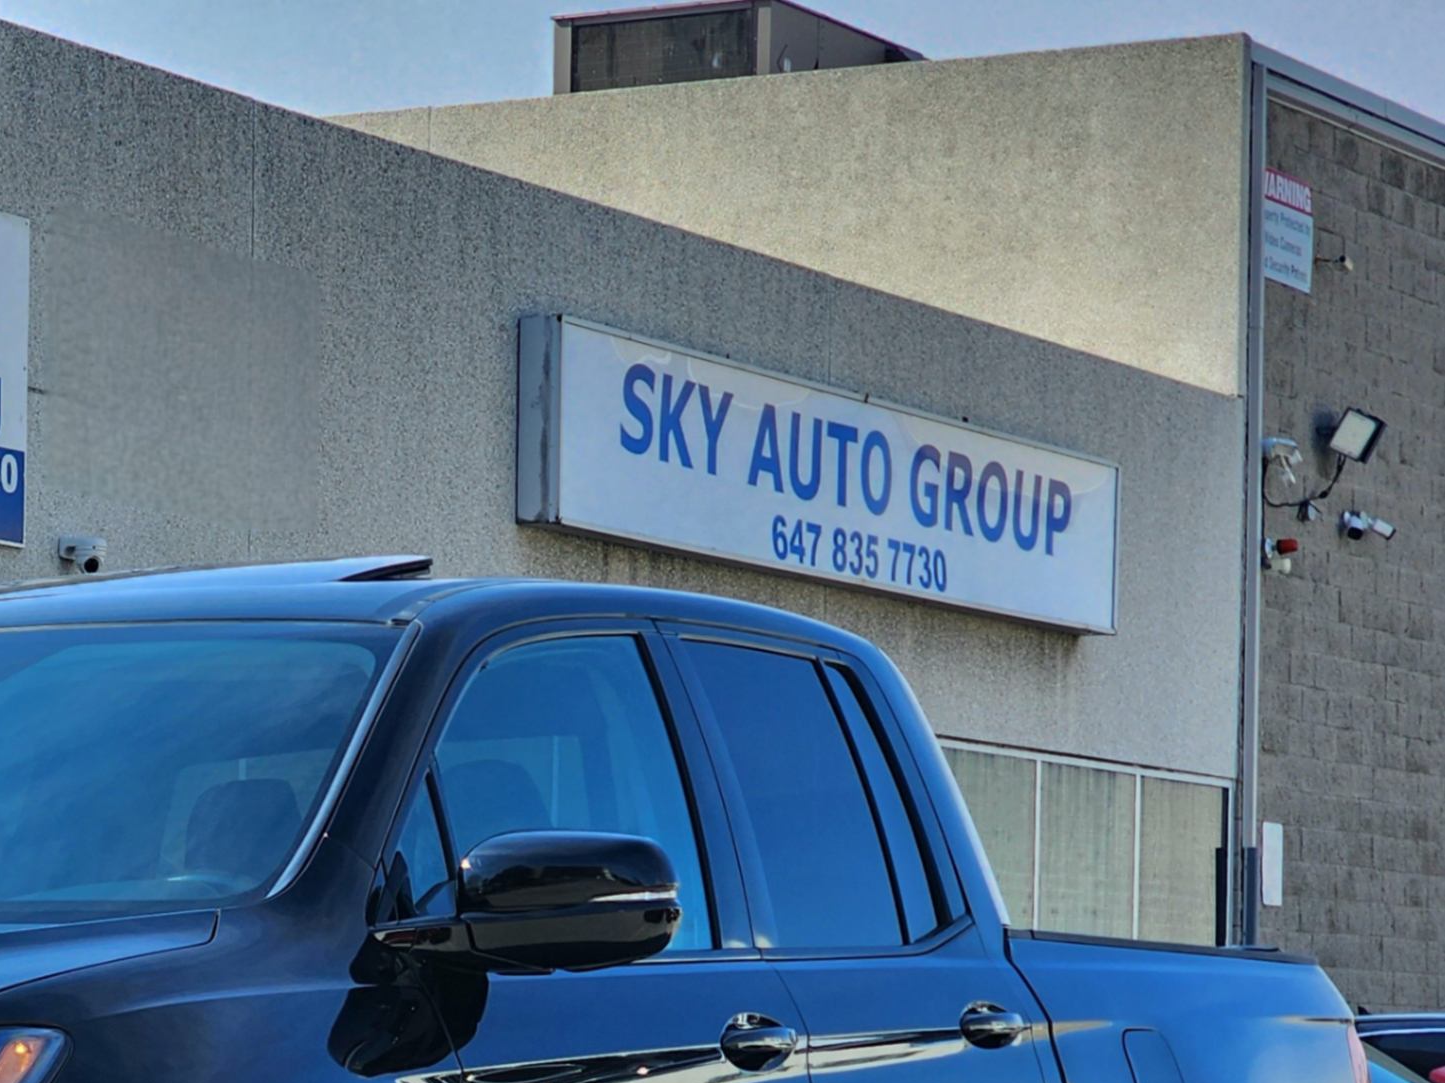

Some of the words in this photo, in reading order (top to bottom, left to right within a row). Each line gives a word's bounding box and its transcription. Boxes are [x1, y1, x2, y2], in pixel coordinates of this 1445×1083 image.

[619, 363, 734, 476] SKY
[747, 403, 893, 516] AUTO
[909, 444, 1073, 557] GROUP
[771, 515, 823, 567] 647
[832, 527, 879, 580] 835
[887, 539, 948, 593] 7730
